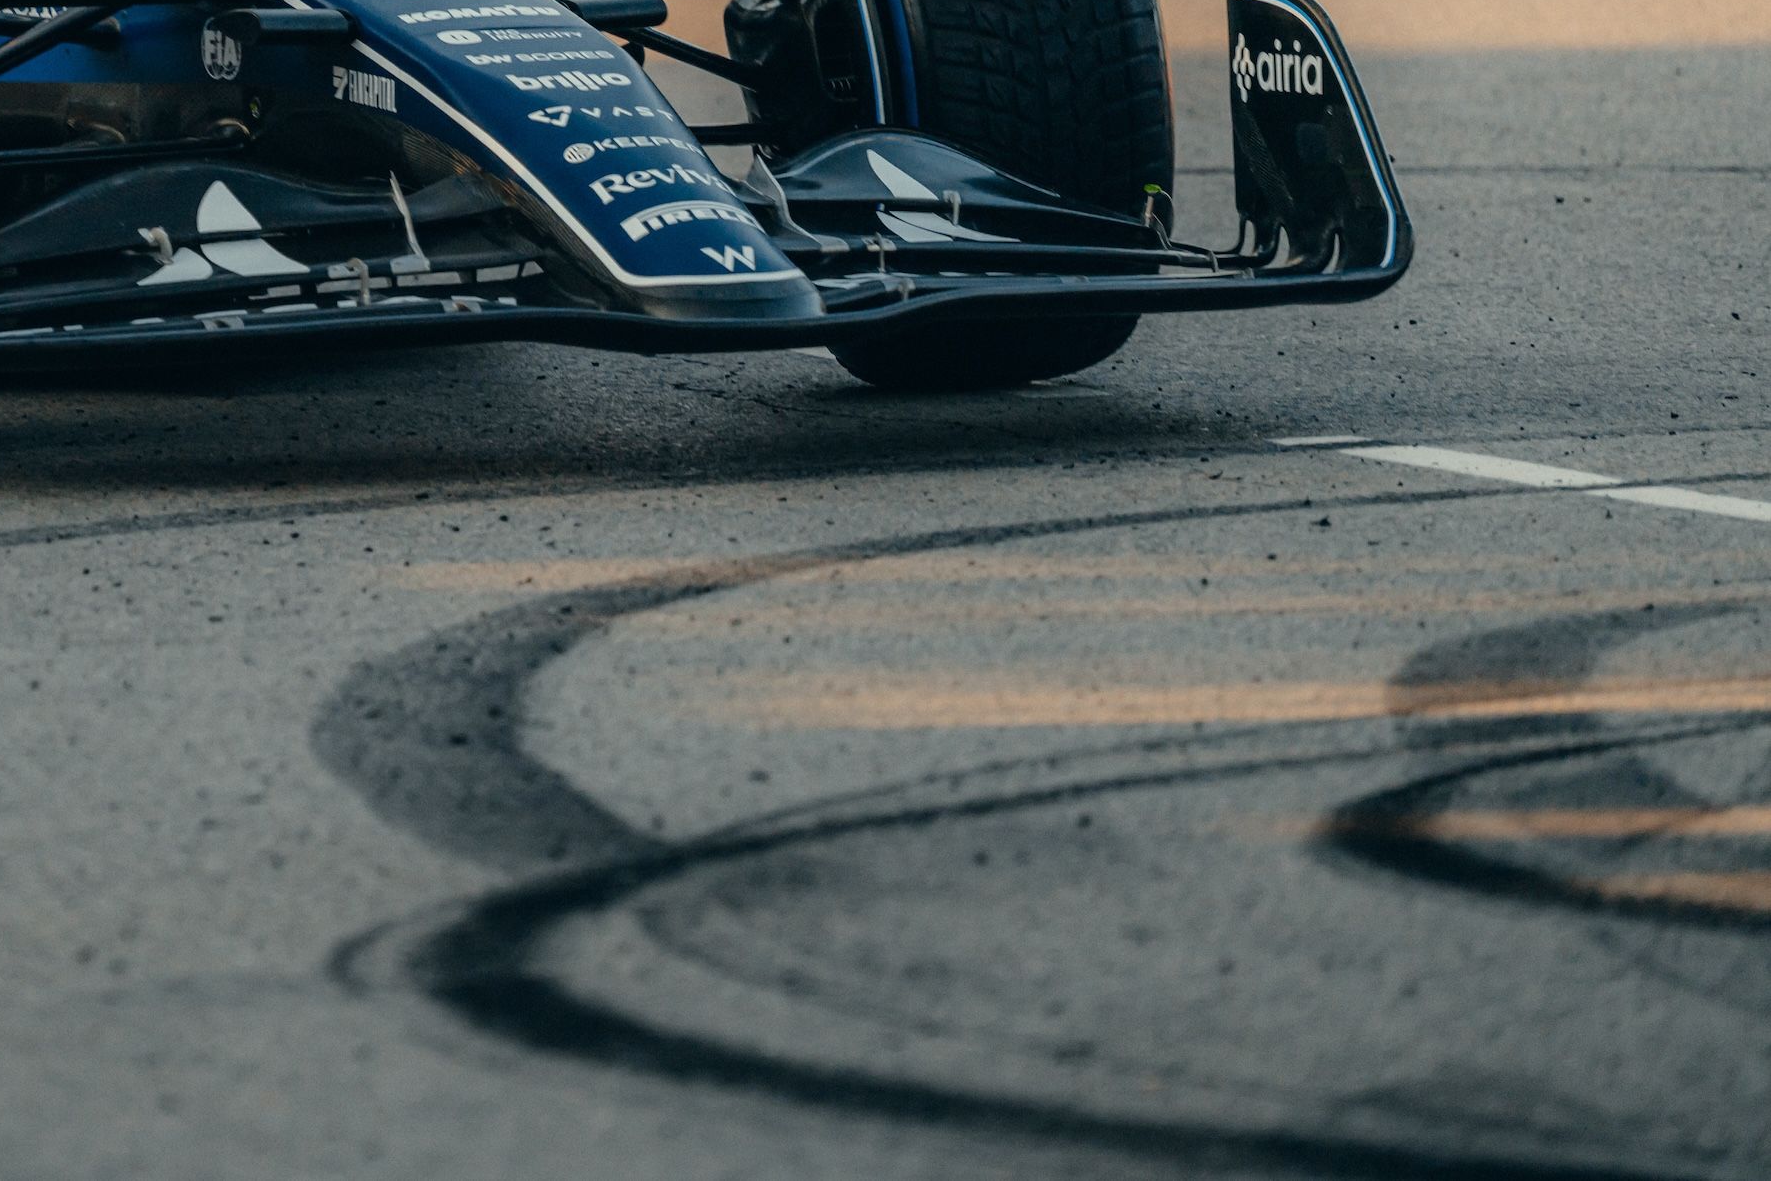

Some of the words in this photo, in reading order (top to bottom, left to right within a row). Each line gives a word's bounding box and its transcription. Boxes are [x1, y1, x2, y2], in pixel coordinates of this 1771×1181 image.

[398, 3, 562, 25] KOMATSU
[203, 29, 238, 68] FIA
[515, 50, 615, 63] SCORES
[1256, 39, 1324, 95] airia
[504, 70, 632, 93] brillio
[580, 105, 674, 122] VAST
[593, 135, 707, 158] KEEPER
